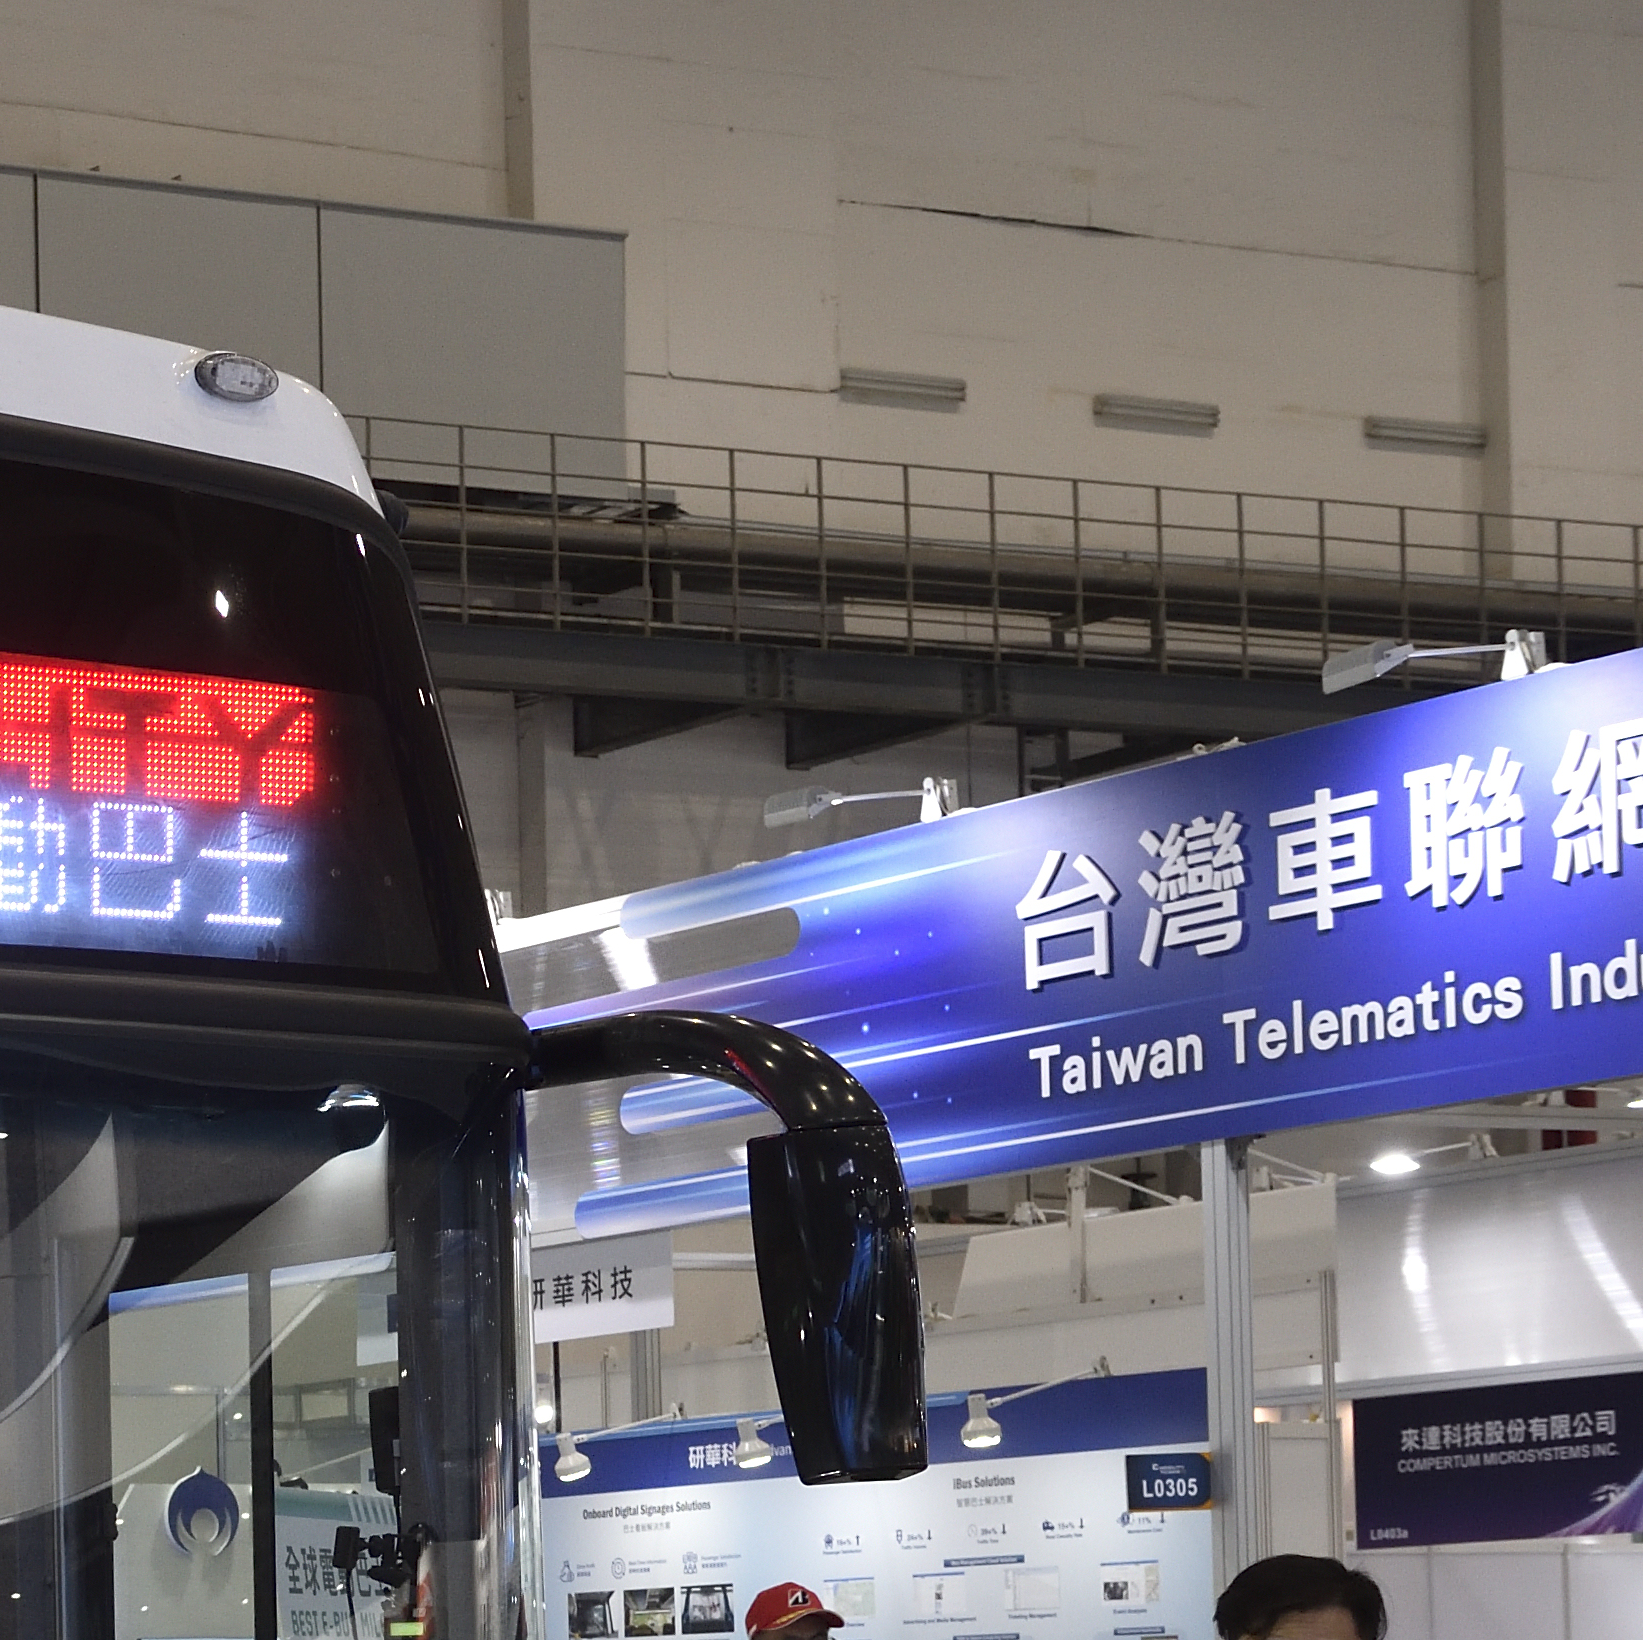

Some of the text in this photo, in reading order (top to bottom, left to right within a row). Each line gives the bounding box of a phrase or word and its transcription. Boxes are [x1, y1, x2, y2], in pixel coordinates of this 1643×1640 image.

[1029, 1032, 1203, 1098] Taiwan
[1223, 971, 1524, 1065] Telematics
[1397, 1453, 1481, 1473] COMPERTUM
[1483, 1444, 1590, 1466] MICROSYSTEMS
[975, 1475, 1015, 1488] Solutions
[1142, 1478, 1198, 1498] L0305
[583, 1507, 613, 1520] Onboard
[615, 1505, 639, 1519] Digital
[676, 1500, 711, 1513] Solutions
[291, 1610, 319, 1637] BEST
[322, 1611, 352, 1638] E-BU
